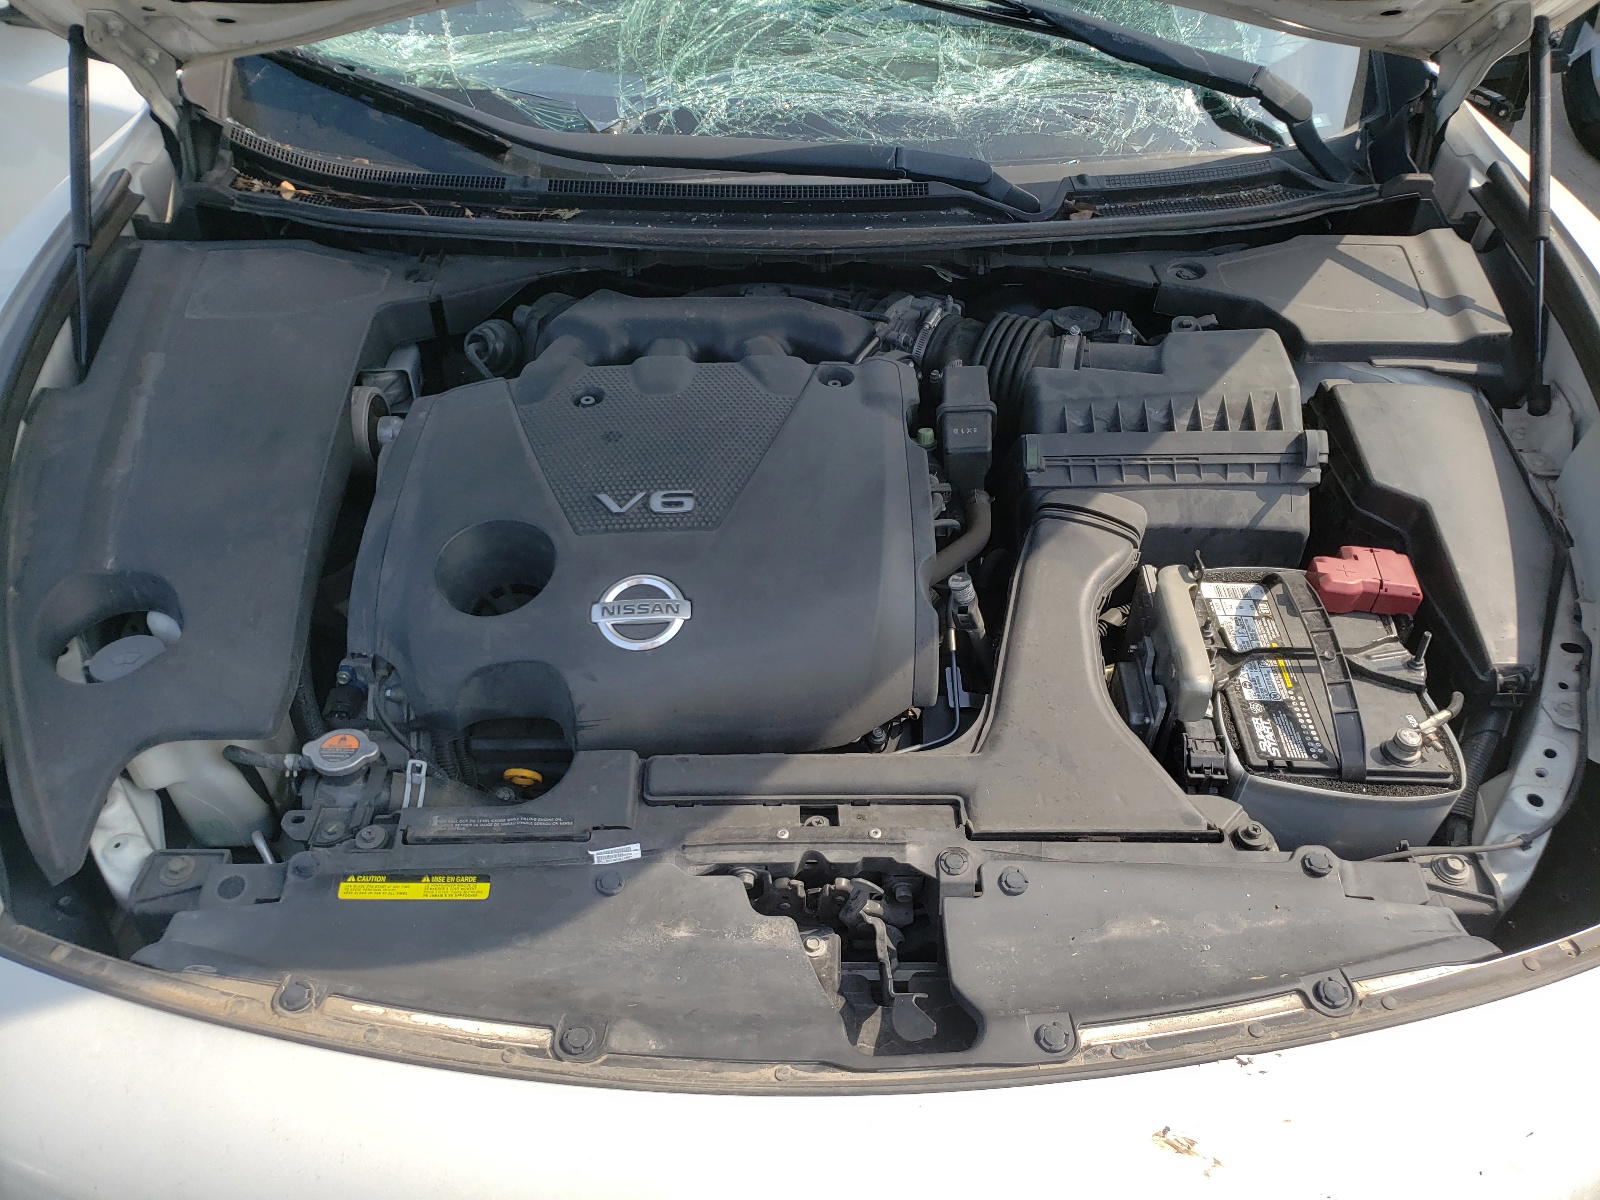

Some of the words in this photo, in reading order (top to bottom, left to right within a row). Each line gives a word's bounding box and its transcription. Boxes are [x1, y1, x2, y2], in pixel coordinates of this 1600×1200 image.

[594, 489, 695, 514] V6
[601, 603, 680, 617] NISSAN
[1252, 716, 1268, 752] SUPER
[1262, 718, 1282, 758] START
